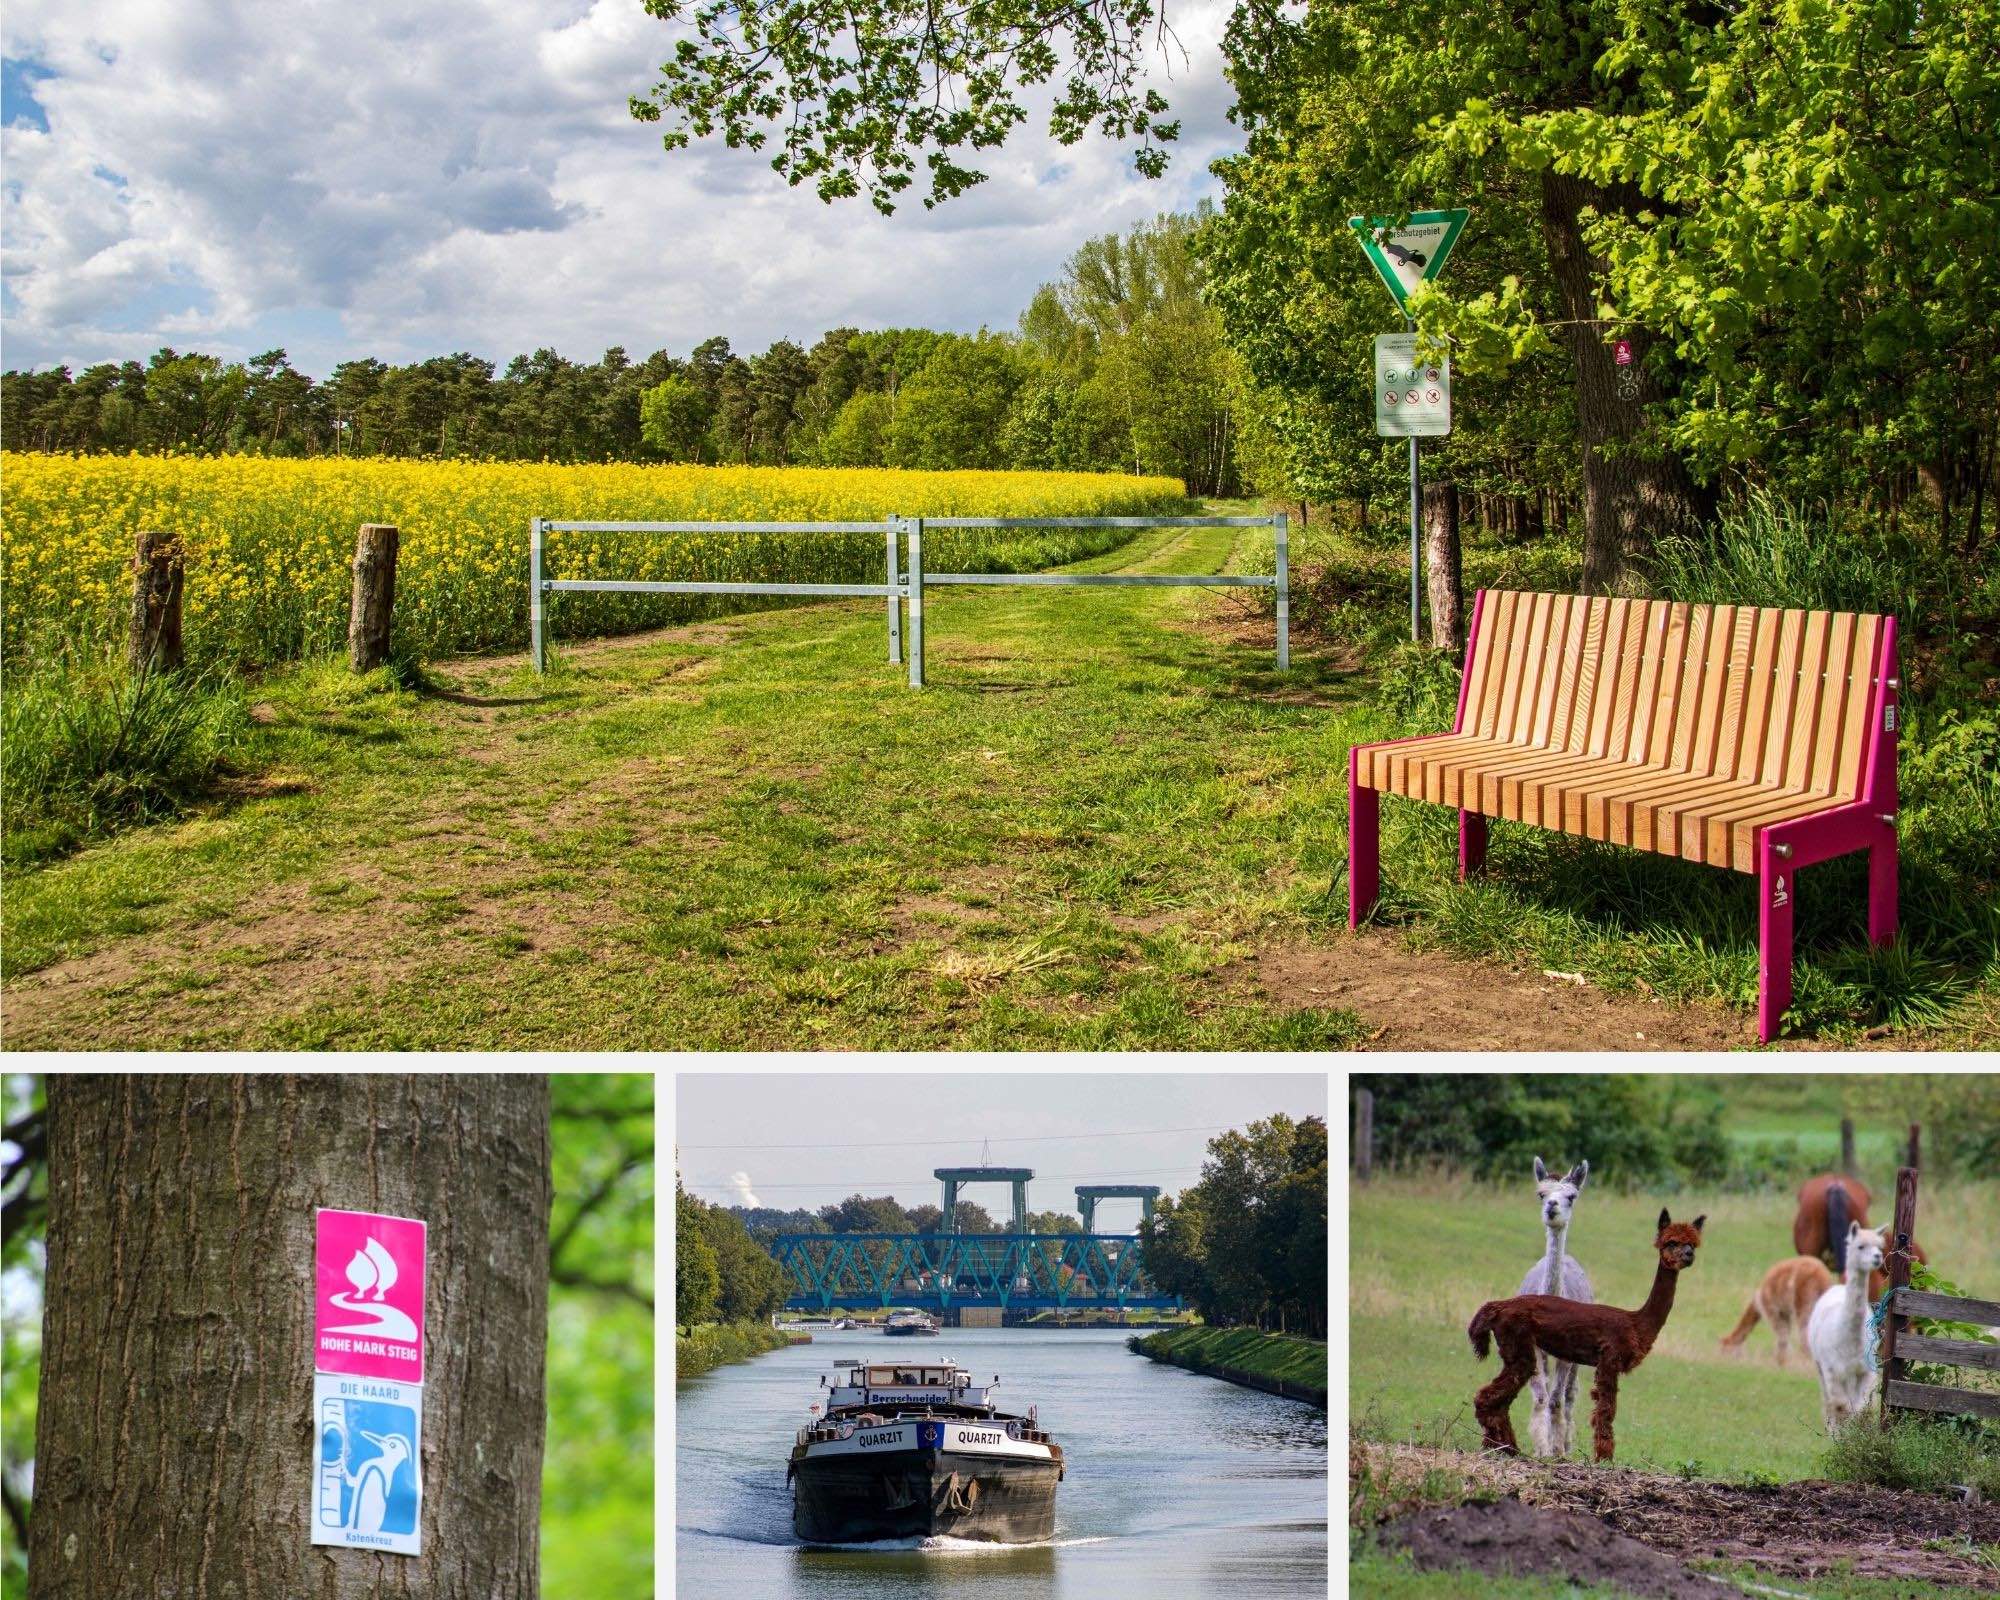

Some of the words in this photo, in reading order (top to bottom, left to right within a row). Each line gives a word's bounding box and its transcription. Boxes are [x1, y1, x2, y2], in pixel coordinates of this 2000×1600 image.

[320, 1336, 352, 1353] HOHE
[353, 1340, 386, 1357] MARK
[387, 1344, 418, 1362] STEIG
[340, 1382, 359, 1395] DIE
[362, 1384, 400, 1400] HAARD
[859, 1431, 903, 1447] QUARZIT
[958, 1431, 1002, 1445] QUARZIT
